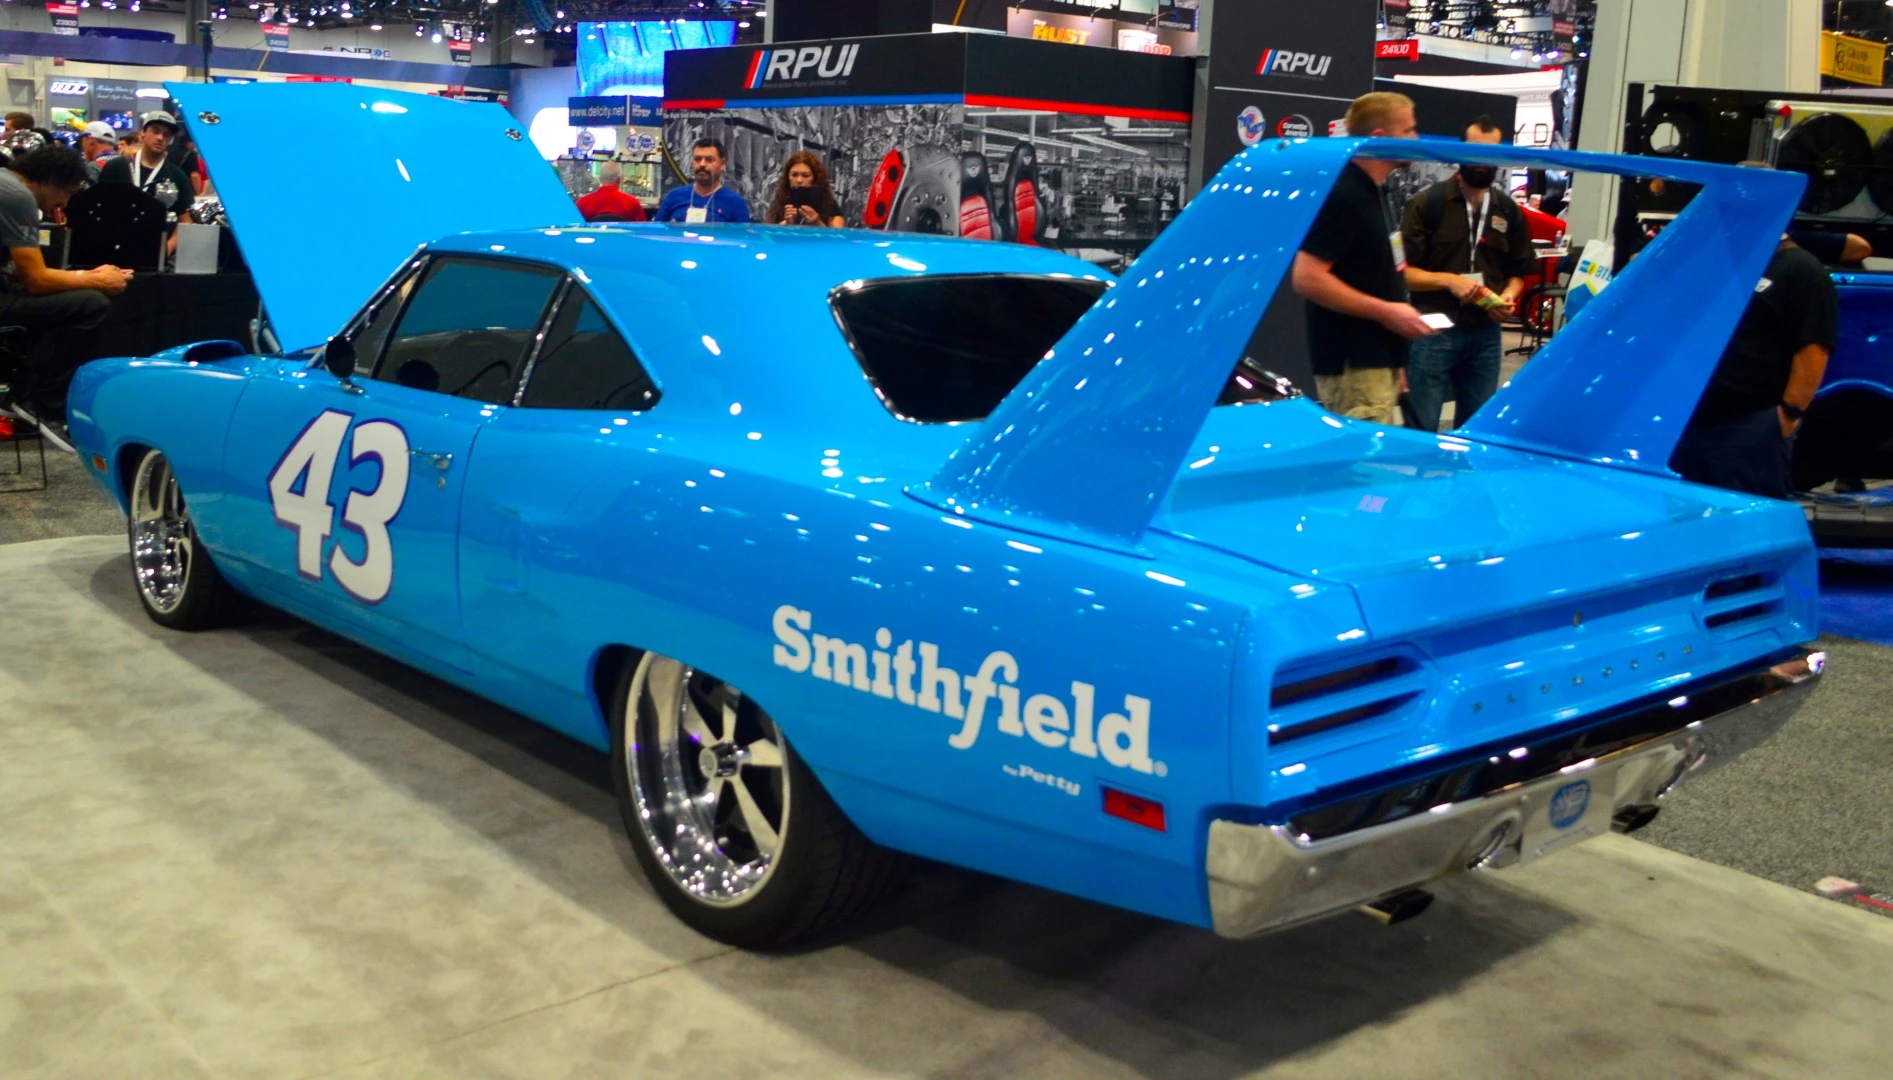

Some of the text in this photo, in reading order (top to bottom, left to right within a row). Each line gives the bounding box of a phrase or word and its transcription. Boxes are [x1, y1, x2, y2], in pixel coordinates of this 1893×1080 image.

[1032, 25, 1092, 45] RUST
[765, 44, 860, 80] RPUI
[1381, 44, 1410, 54] 24100
[1271, 50, 1332, 76] RPUI
[1282, 122, 1308, 130] Corvette
[268, 408, 410, 604] 43
[1019, 764, 1081, 796] Petty
